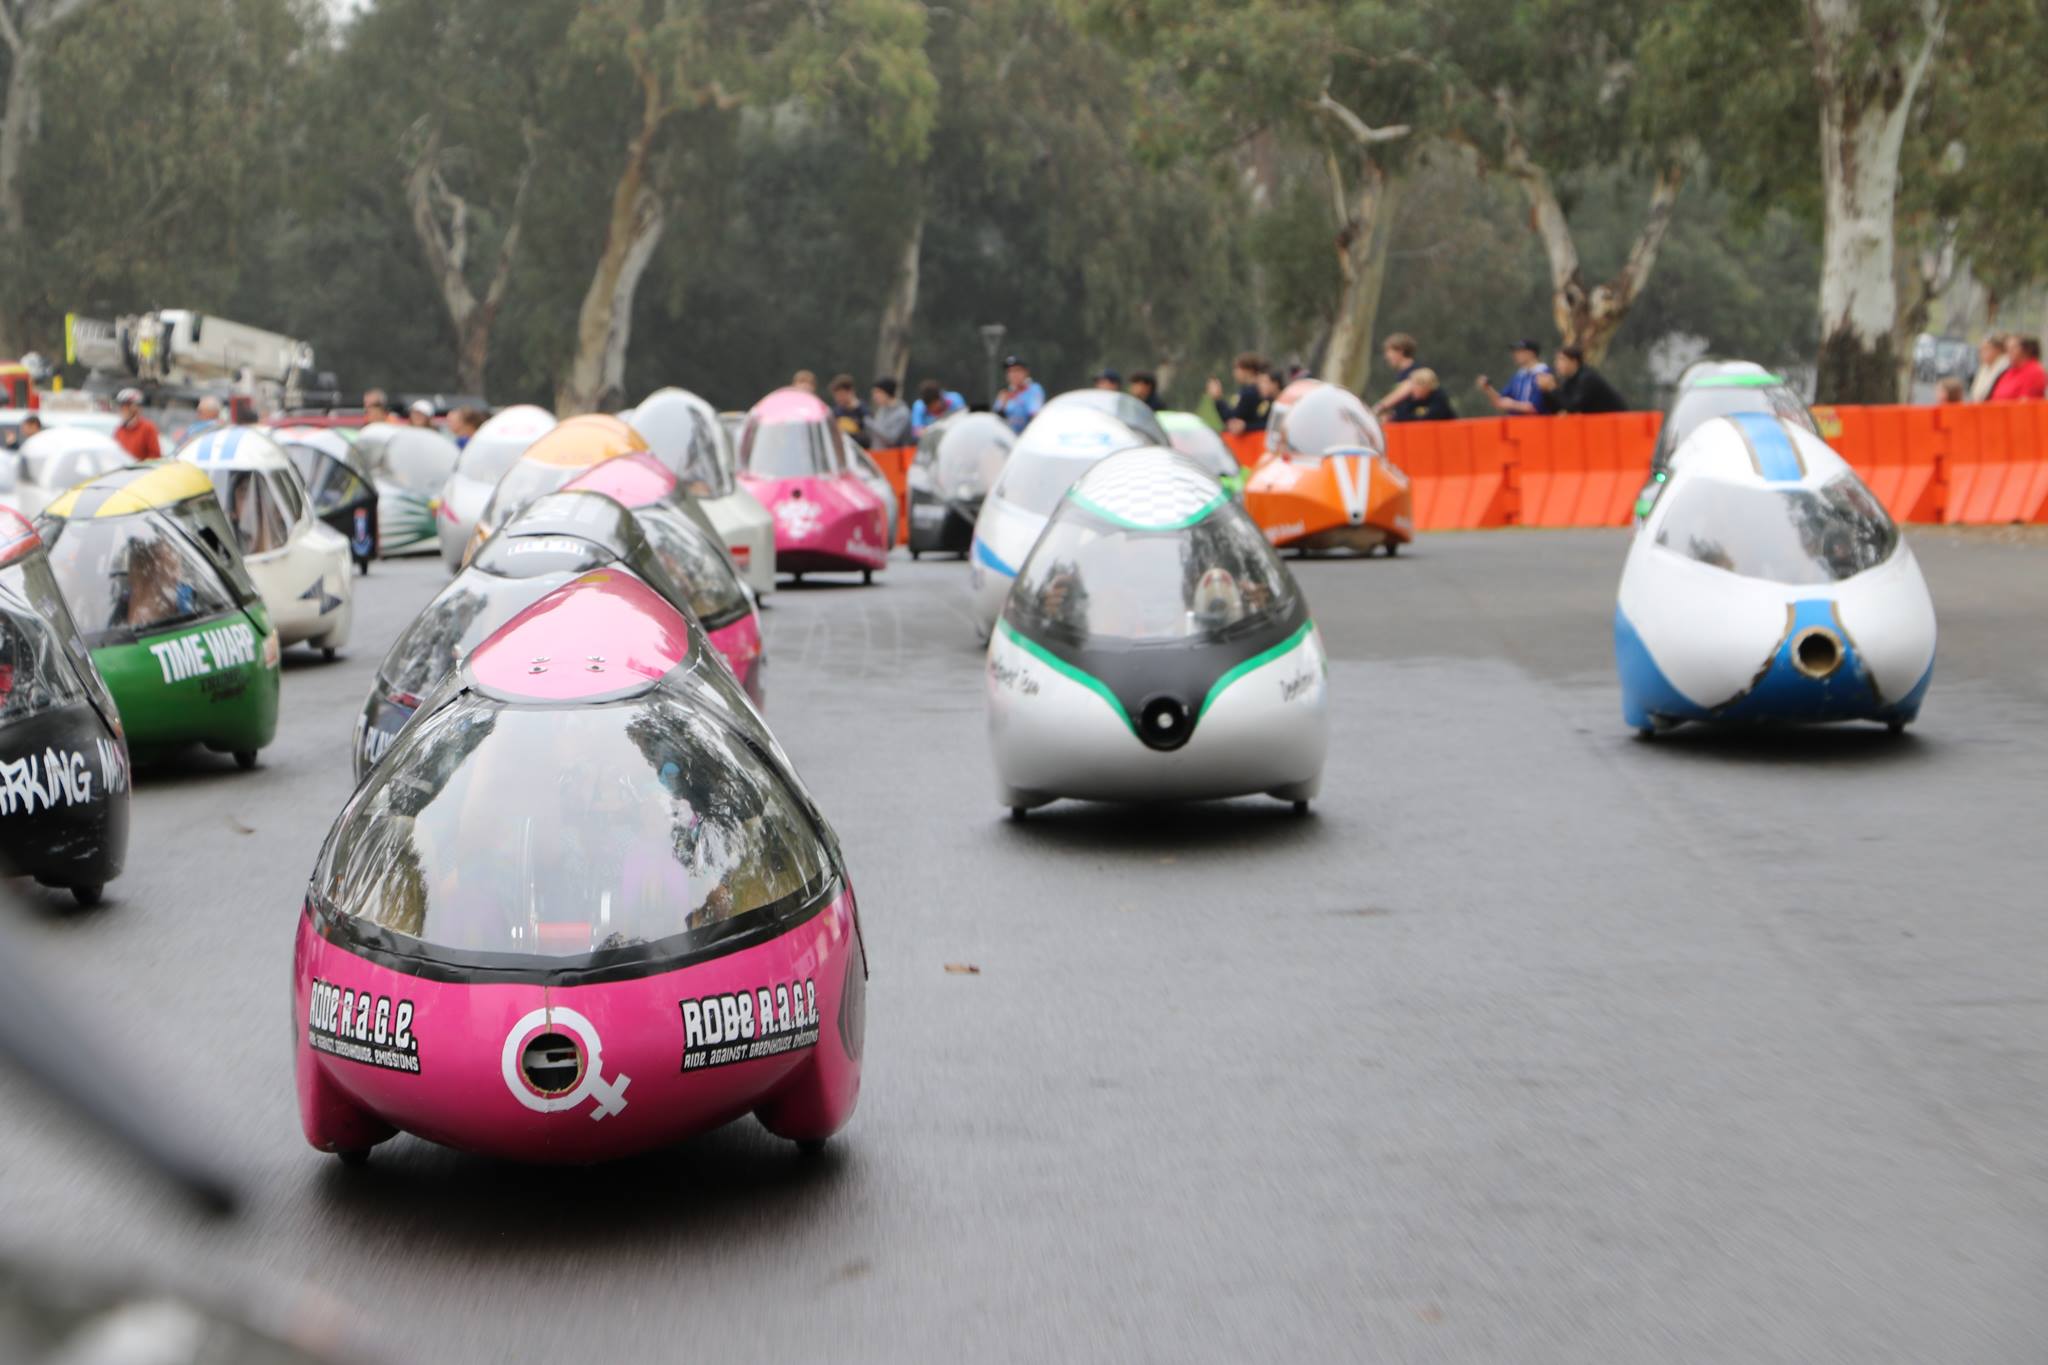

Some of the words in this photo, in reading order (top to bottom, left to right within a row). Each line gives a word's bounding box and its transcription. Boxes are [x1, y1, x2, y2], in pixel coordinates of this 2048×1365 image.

[149, 633, 212, 684] TIME
[202, 623, 256, 670] WARP
[0, 747, 92, 816] RKING
